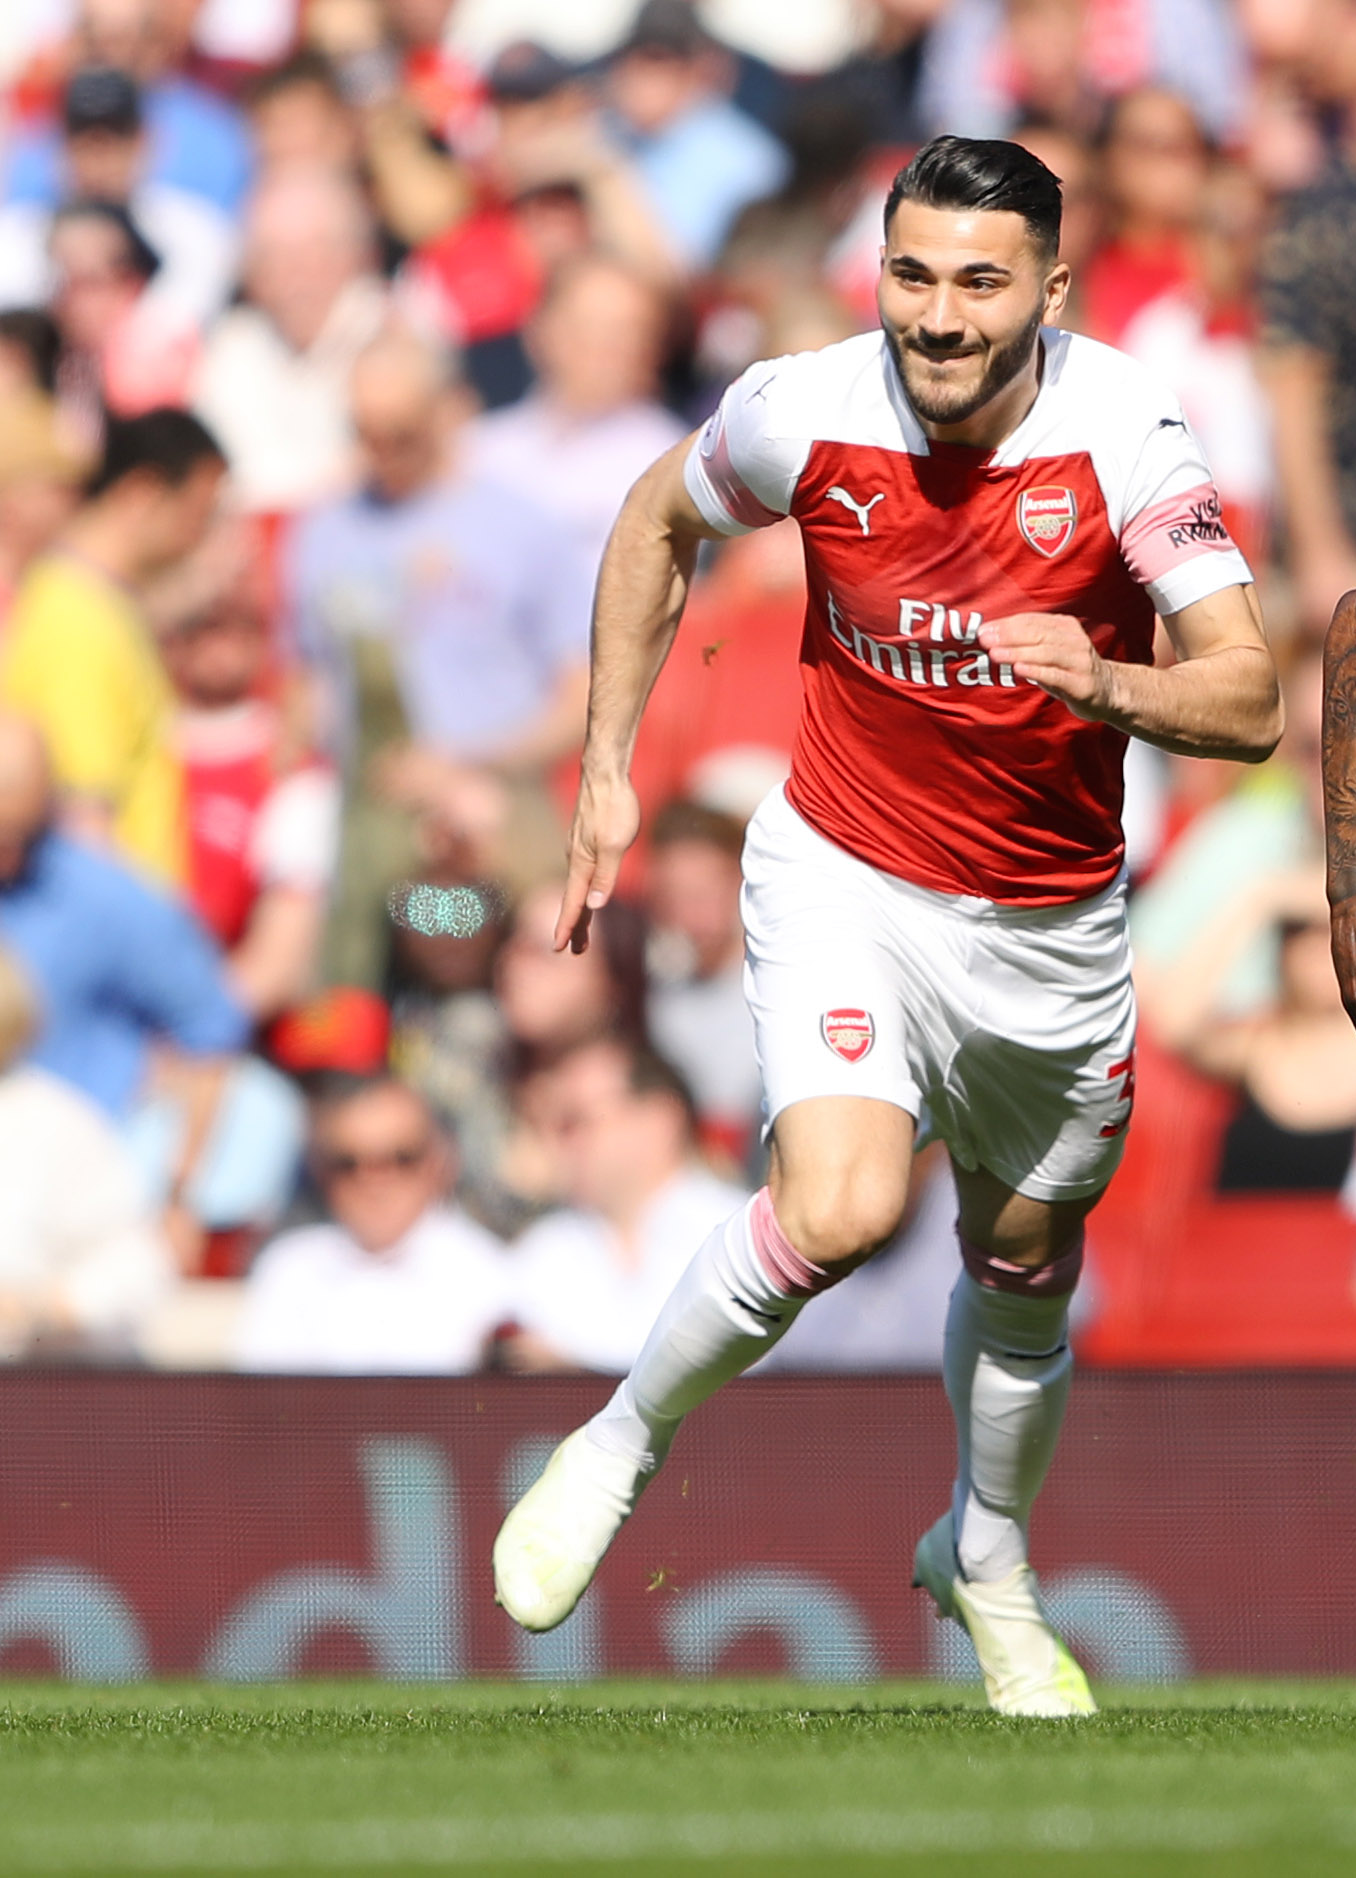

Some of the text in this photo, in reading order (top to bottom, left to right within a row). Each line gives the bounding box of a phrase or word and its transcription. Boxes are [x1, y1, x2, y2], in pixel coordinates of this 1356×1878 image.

[1024, 496, 1070, 511] Arsenal
[826, 589, 1039, 689] Emira
[898, 597, 983, 645] Fly
